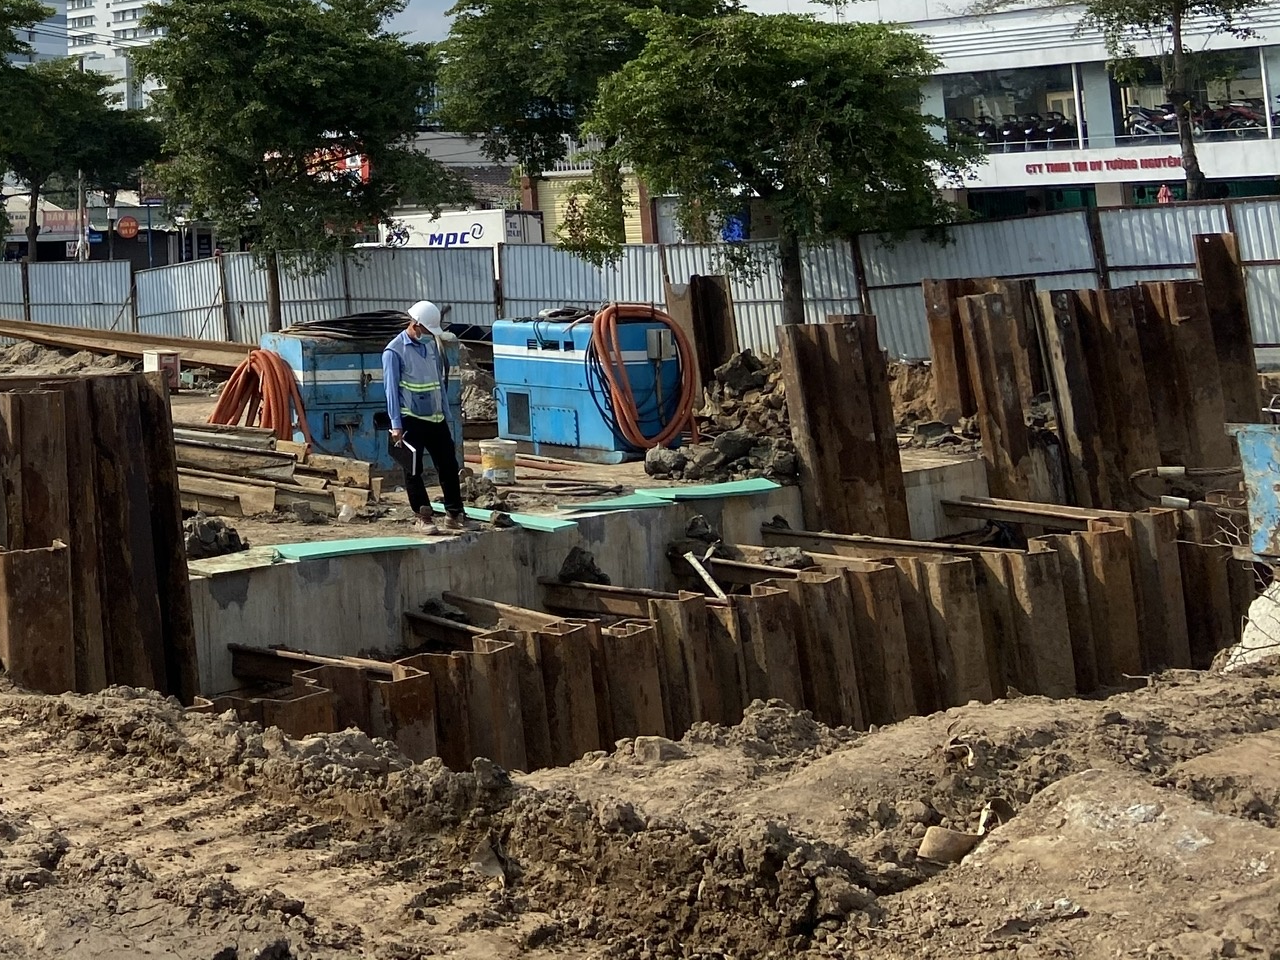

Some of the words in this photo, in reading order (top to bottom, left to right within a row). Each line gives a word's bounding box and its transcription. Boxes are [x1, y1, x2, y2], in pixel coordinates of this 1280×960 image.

[1026, 164, 1043, 174] CTY
[1072, 161, 1088, 172] TM
[1089, 160, 1102, 171] DV
[1104, 157, 1138, 170] TƯỜNG
[1140, 155, 1182, 169] NGUYÊN
